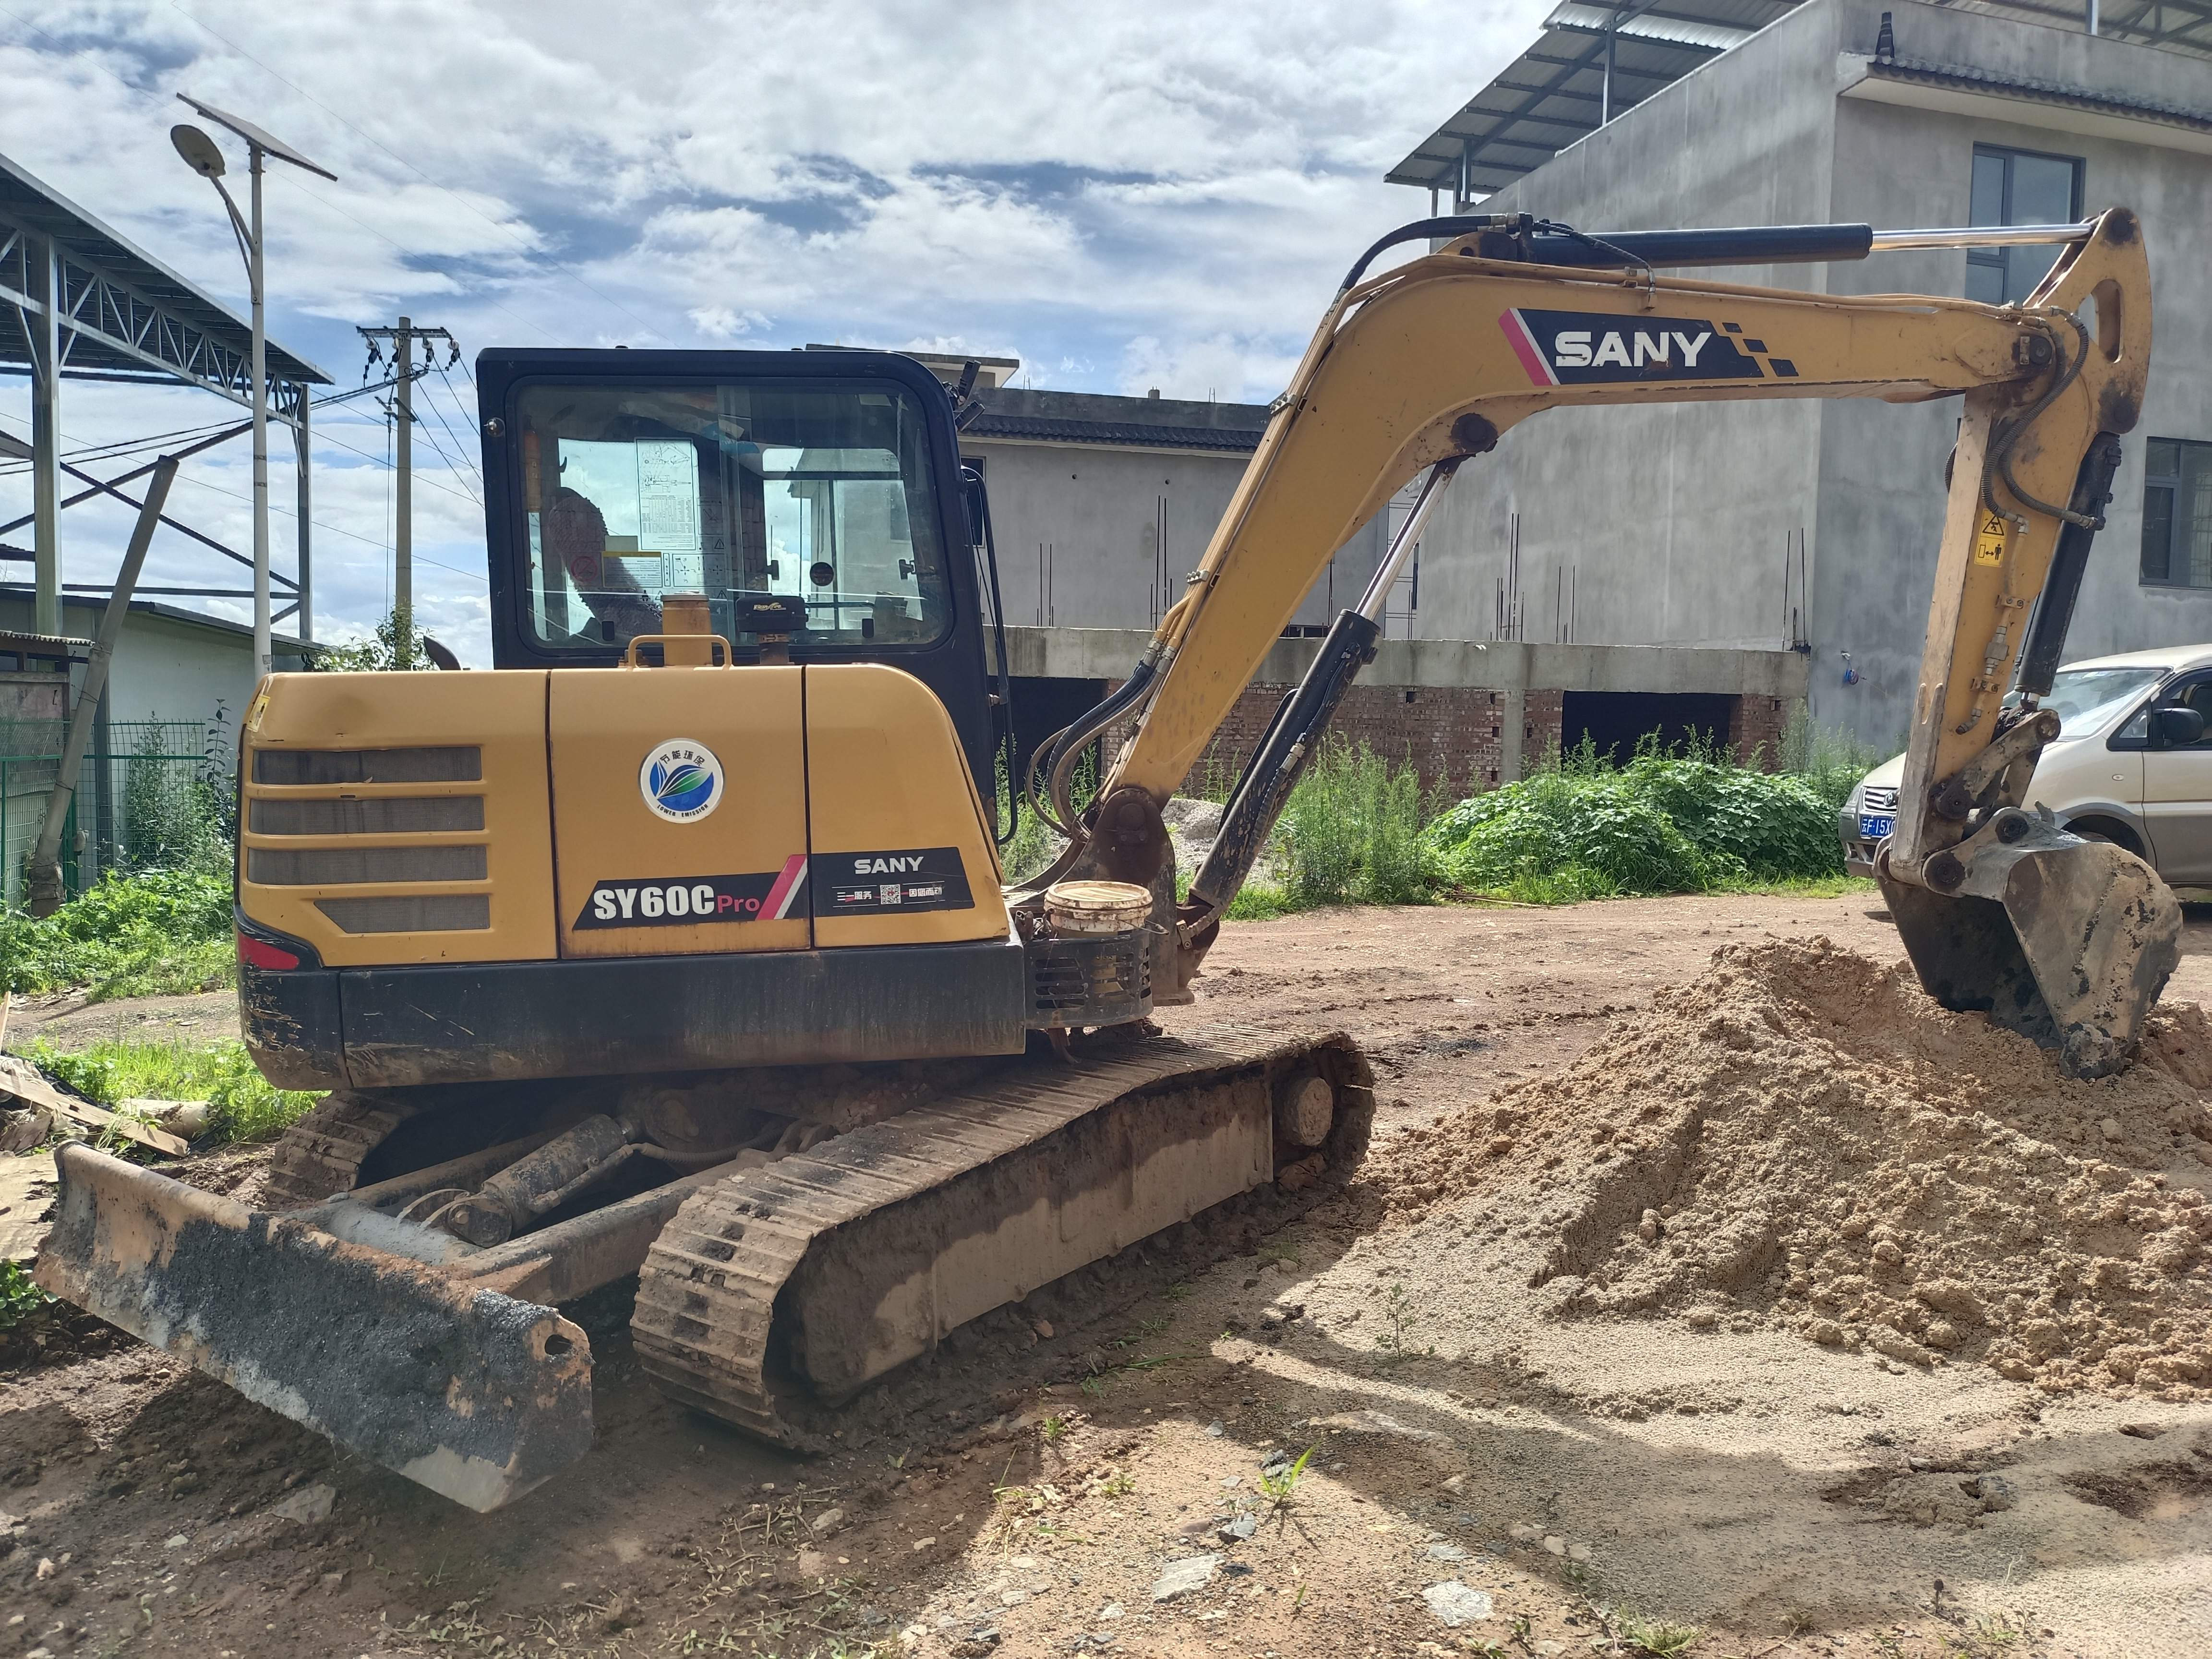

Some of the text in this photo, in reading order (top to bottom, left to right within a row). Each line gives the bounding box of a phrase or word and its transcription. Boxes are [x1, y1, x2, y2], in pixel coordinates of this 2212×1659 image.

[1555, 331, 1712, 367] SANY
[660, 750, 705, 767] 节能环保
[657, 804, 709, 817] LOWER EMISSION
[854, 856, 924, 875] SANY
[909, 886, 942, 898] 因您而动
[593, 885, 760, 920] SY60C Pro
